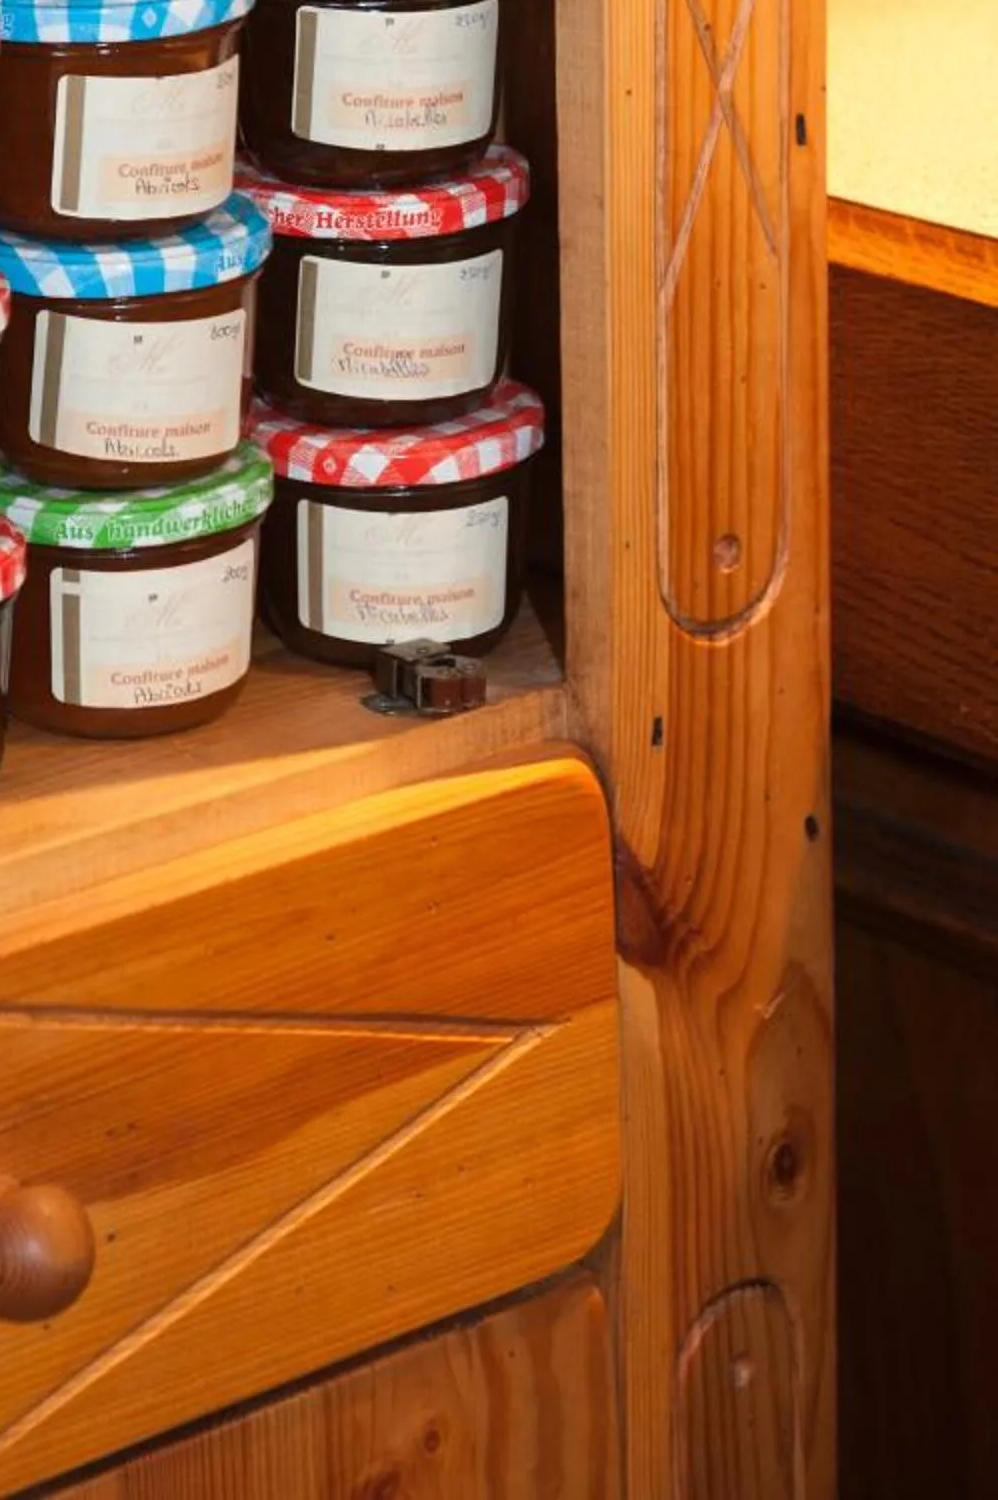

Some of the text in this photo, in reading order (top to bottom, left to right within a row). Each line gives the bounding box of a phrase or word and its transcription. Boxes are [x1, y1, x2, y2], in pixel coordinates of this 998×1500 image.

[341, 91, 415, 109] Confiture
[117, 161, 187, 180] Confiture
[314, 207, 443, 230] Herstellung
[85, 420, 159, 438] Confiture
[56, 519, 95, 541] Aus
[110, 668, 183, 687] Confiture
